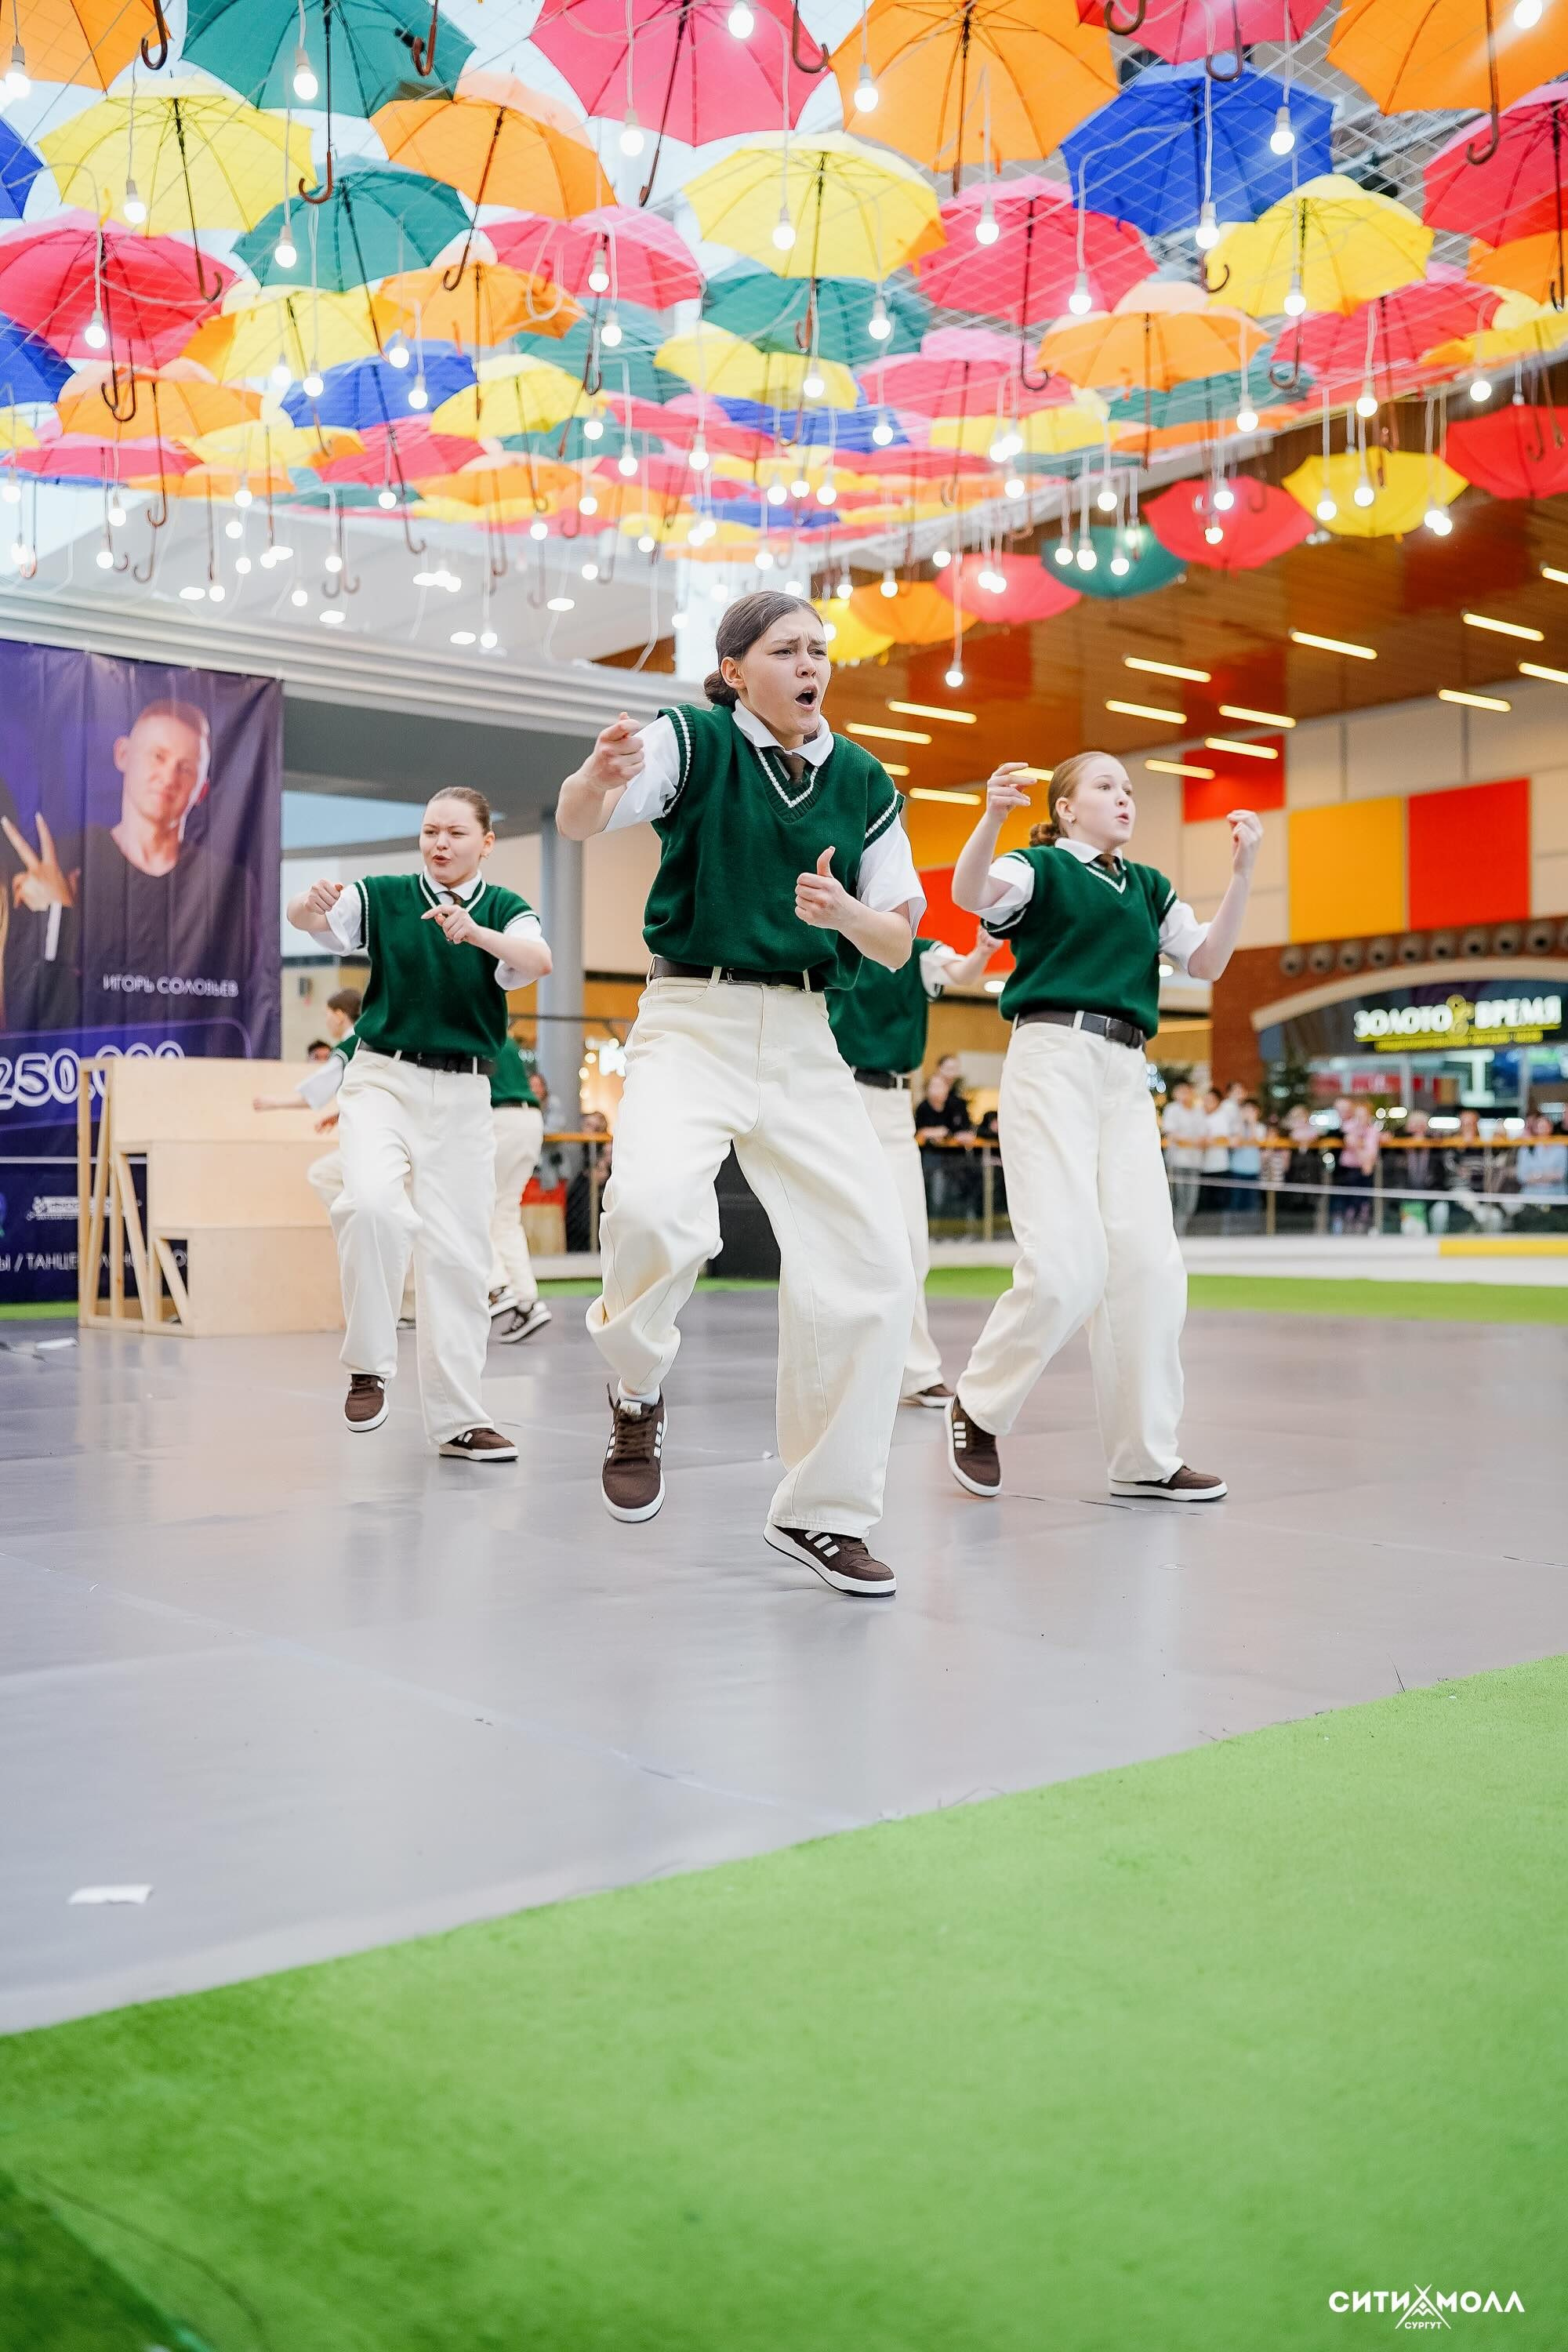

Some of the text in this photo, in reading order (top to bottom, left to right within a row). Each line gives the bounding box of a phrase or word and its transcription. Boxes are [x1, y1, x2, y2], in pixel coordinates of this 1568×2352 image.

[103, 974, 239, 997] ИГОРЬ СОЛОВЬЕВ
[1354, 995, 1563, 1037] ЗОЛОТО ВРЕМЯ
